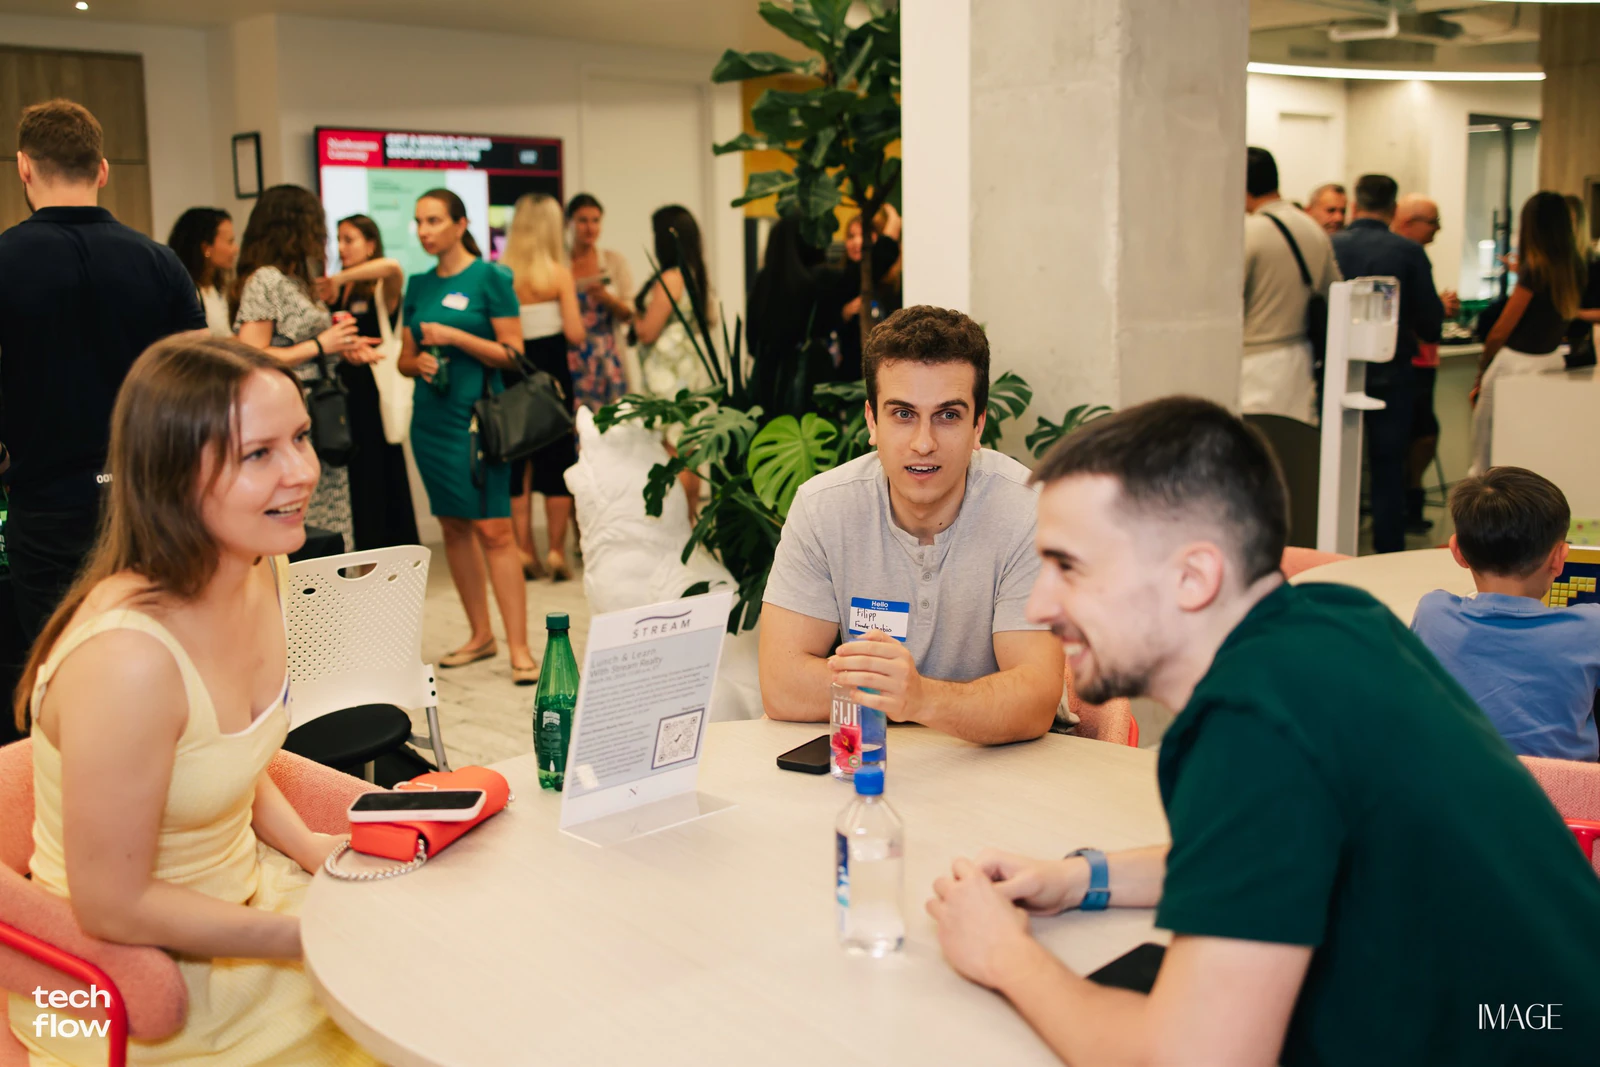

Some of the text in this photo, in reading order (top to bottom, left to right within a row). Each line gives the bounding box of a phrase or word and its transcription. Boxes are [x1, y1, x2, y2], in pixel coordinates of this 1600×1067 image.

[871, 600, 889, 608] Hello
[632, 618, 691, 639] STREAM
[631, 648, 657, 660] Learn
[832, 699, 857, 727] FIJI
